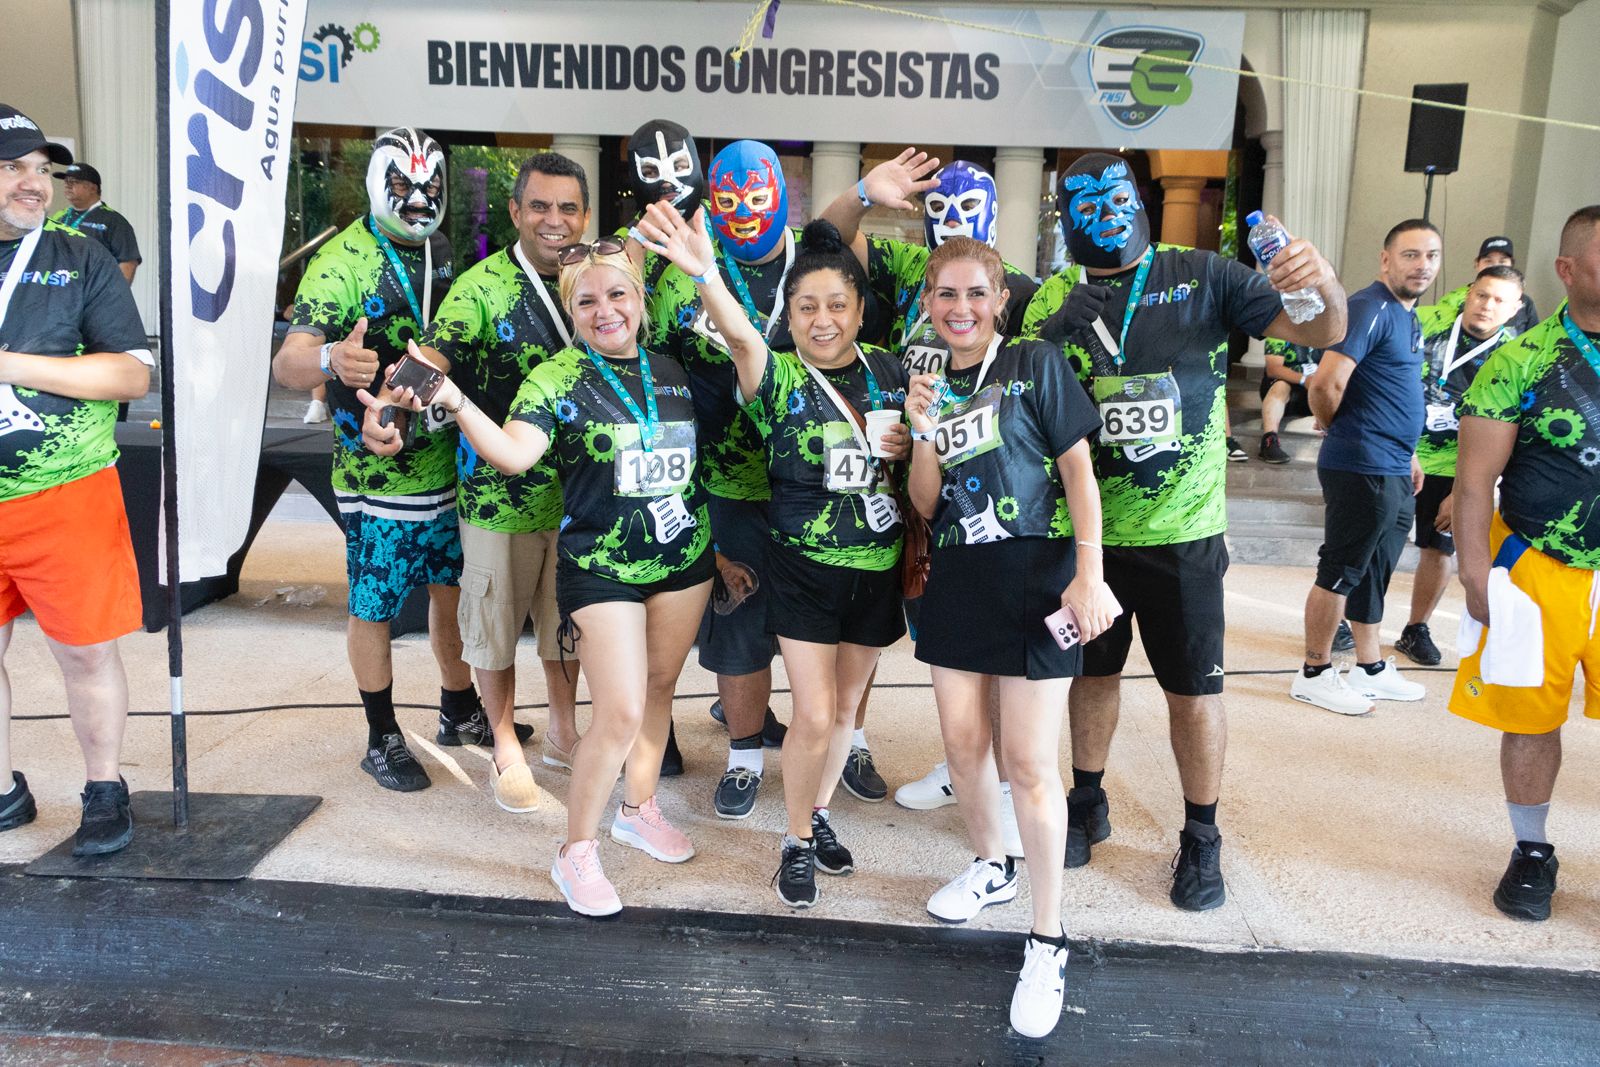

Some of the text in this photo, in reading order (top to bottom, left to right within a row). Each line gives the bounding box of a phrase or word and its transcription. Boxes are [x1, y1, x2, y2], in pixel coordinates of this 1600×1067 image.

[427, 40, 1000, 100] BIENVENIDOS CONGRESISTAS
[261, 85, 281, 181] Agua
[904, 349, 943, 375] 640
[934, 412, 985, 456] 051
[1105, 404, 1169, 436] 639
[629, 453, 686, 484] 108
